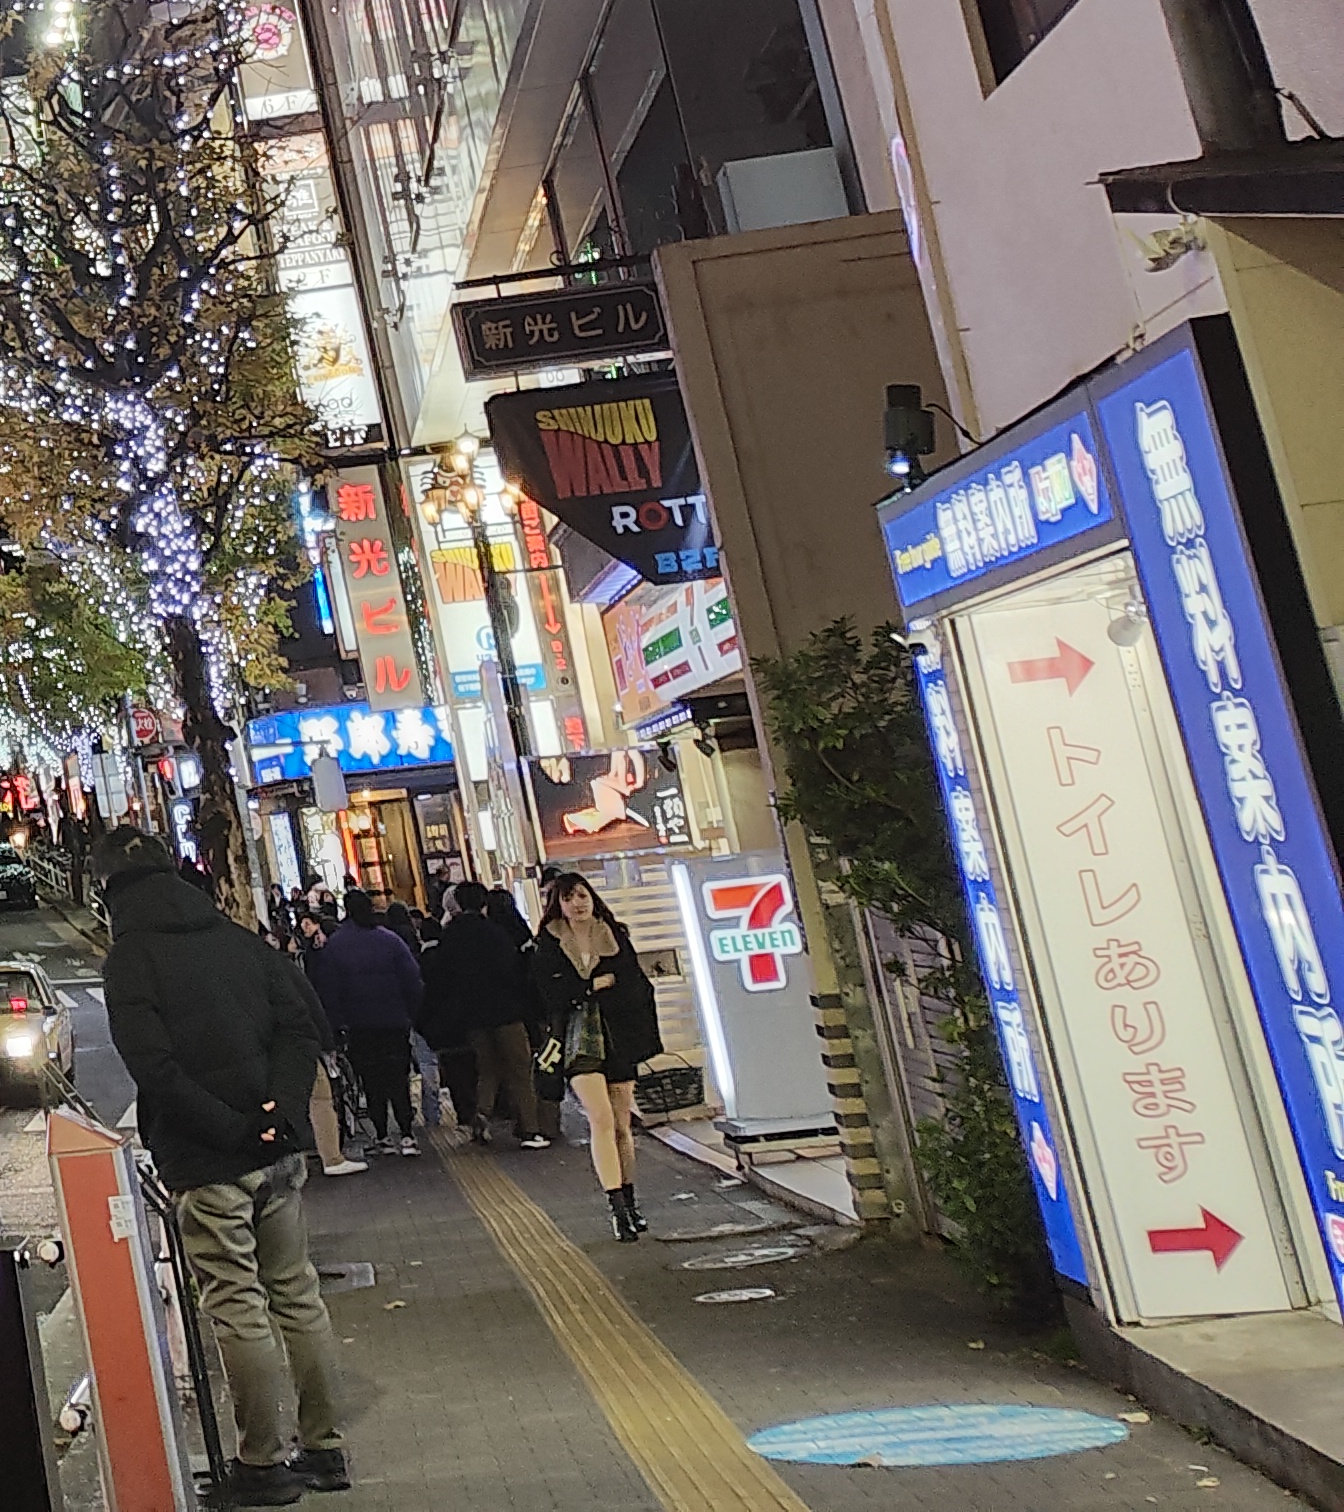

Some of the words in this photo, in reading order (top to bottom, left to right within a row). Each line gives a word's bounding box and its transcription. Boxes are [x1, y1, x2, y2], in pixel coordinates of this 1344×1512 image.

[480, 301, 648, 352] 新光ビル
[534, 398, 659, 446] SHINJUKU
[538, 430, 663, 500] WALLY
[936, 461, 1038, 578] 無料案内所
[337, 483, 411, 694] 新光ビル
[1133, 400, 1344, 1162] 無料案内所
[1045, 725, 1206, 1185] トイレあります
